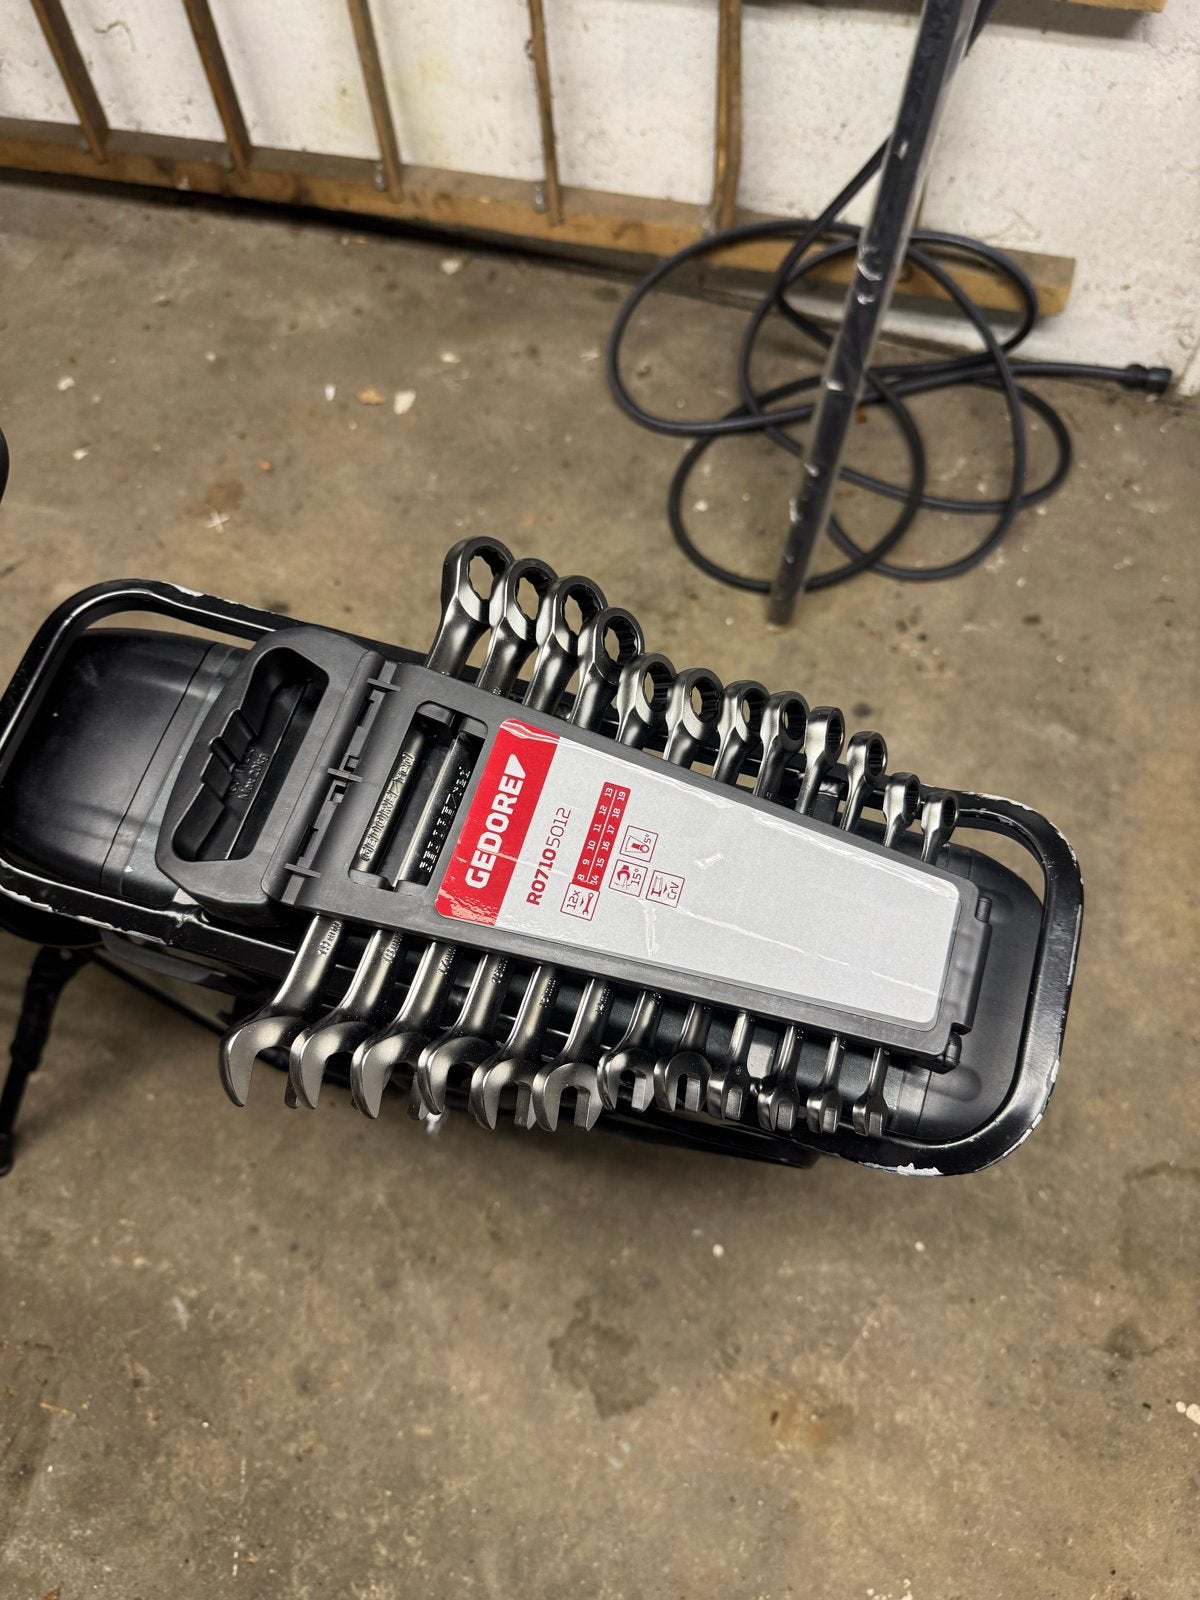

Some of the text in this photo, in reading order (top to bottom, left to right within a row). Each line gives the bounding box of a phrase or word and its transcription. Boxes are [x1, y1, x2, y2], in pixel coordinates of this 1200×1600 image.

[465, 775, 524, 889] GEDORE
[577, 787, 613, 881] 8 9 10 11 12 13
[590, 791, 626, 886] 14 15 16 17 18 19
[566, 889, 581, 910] 12x
[667, 881, 680, 900] CrV
